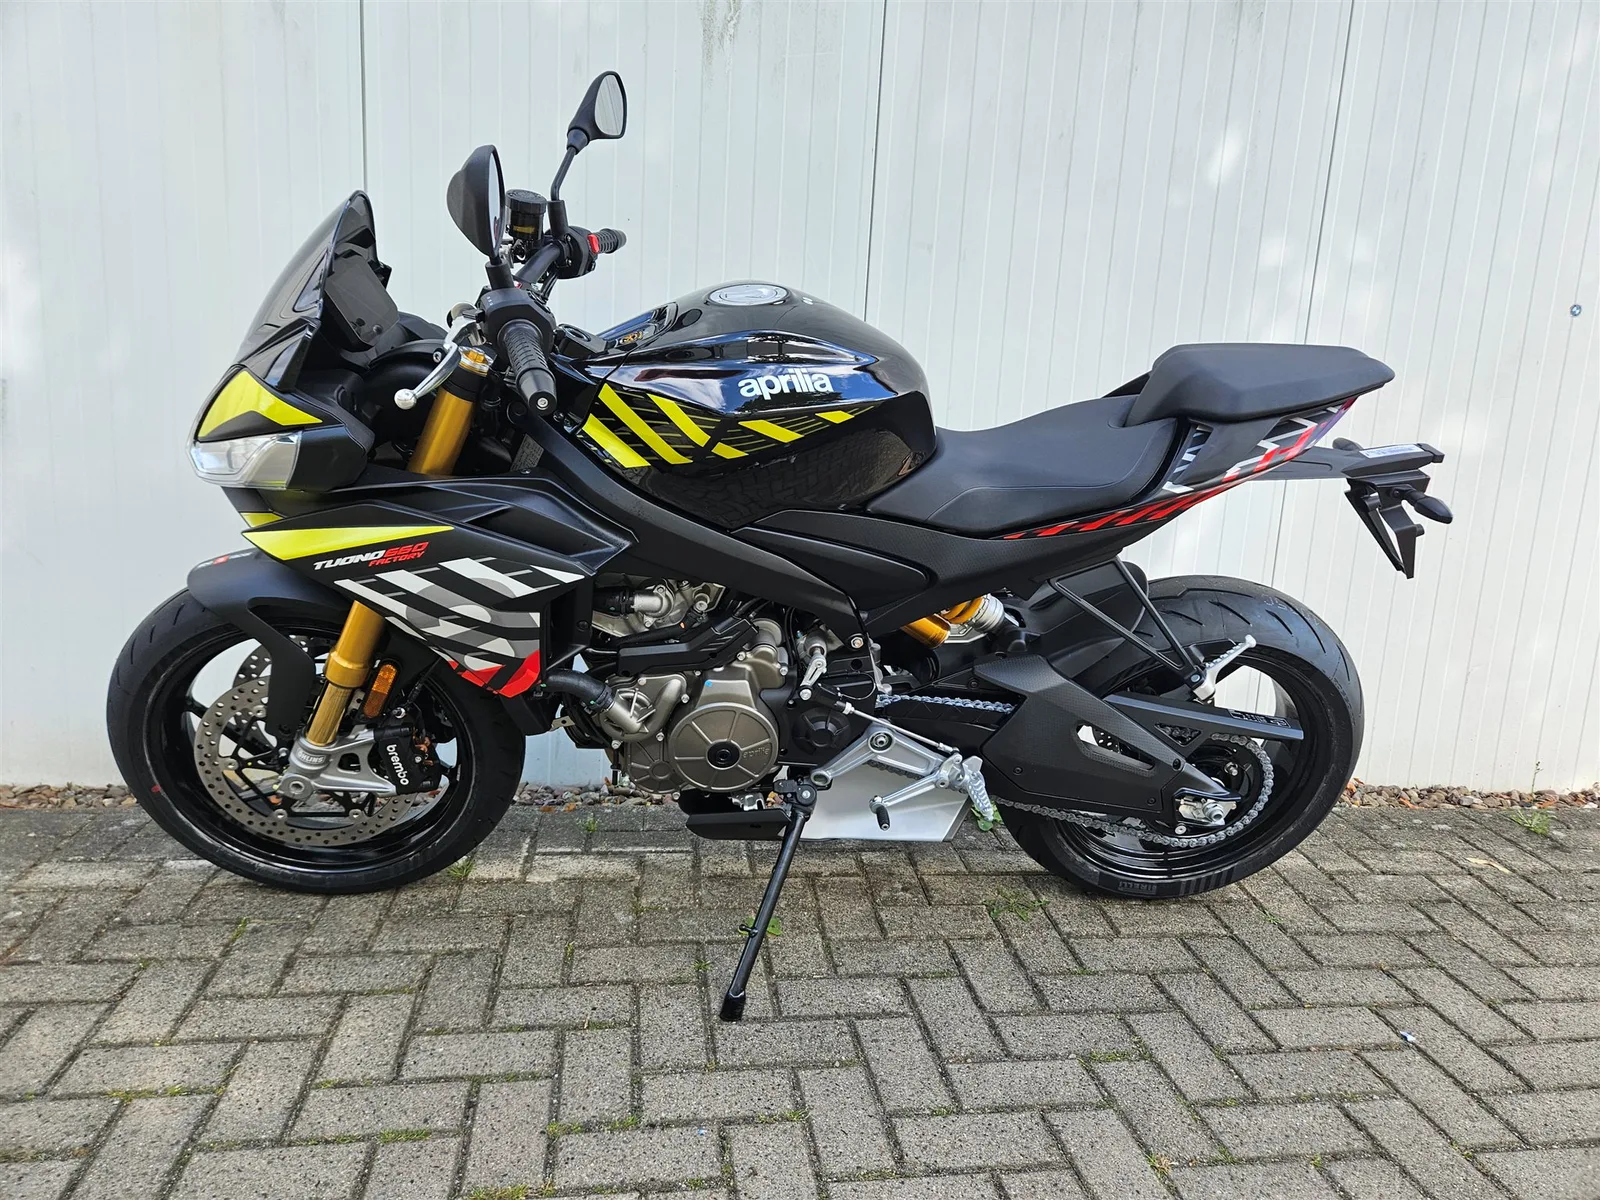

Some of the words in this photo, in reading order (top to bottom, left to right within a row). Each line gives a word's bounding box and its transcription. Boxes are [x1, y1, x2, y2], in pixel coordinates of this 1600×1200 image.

[738, 368, 834, 400] aprilia
[368, 551, 425, 567] FACTORY
[386, 744, 409, 786] brembo
